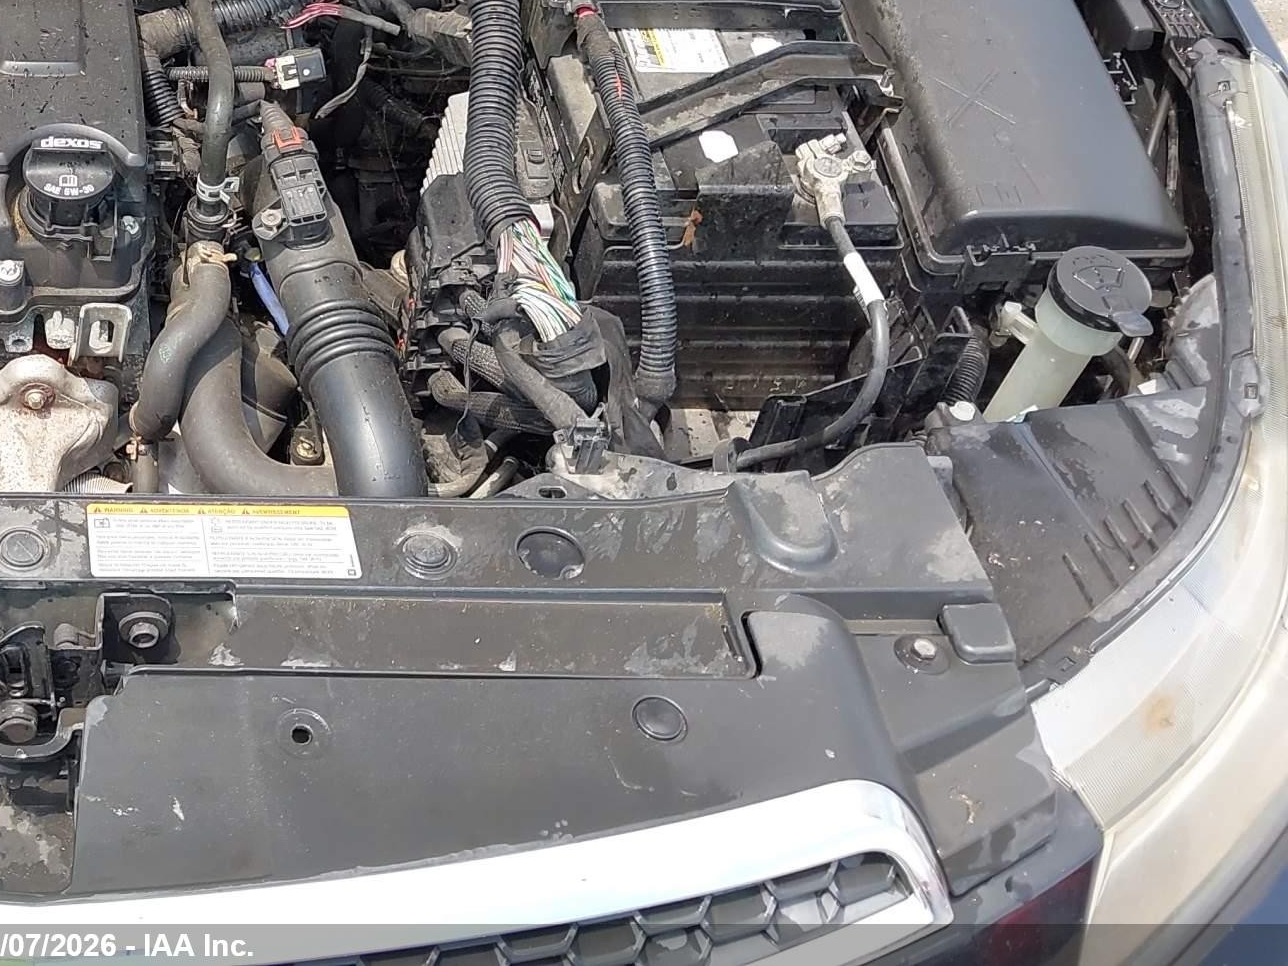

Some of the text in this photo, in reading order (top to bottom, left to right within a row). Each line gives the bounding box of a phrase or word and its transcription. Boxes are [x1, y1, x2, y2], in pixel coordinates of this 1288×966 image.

[40, 136, 104, 150] dexos
[43, 183, 95, 196] SAE 5W-30
